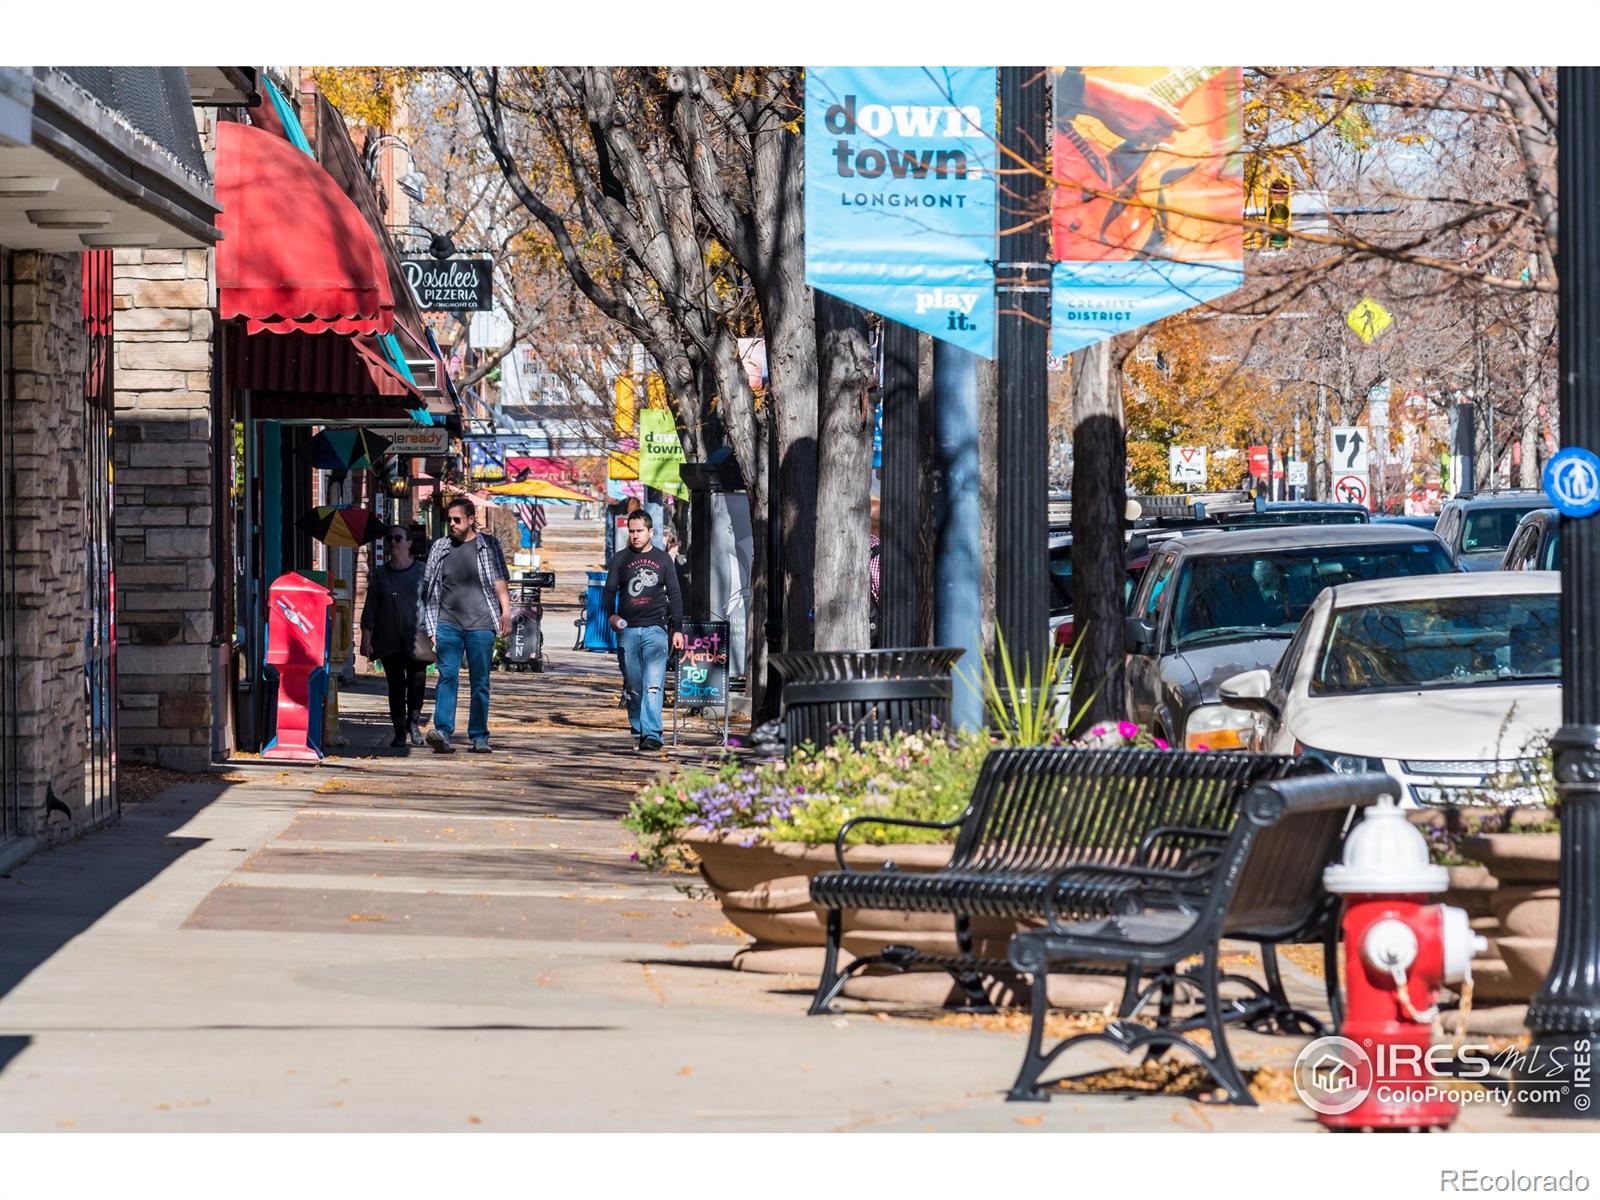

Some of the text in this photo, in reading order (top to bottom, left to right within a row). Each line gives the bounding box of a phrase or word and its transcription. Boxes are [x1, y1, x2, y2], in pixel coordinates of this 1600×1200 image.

[824, 94, 986, 138] down
[841, 192, 967, 208] LONGMONT
[401, 262, 480, 308] Rosalee's
[424, 289, 478, 300] PIZZERIA
[915, 287, 979, 315] play
[1068, 299, 1135, 308] CREATIVE
[947, 310, 977, 331] it.
[1067, 311, 1132, 321] DISTRICT
[515, 614, 524, 657] OPEN
[683, 632, 721, 652] Lost
[679, 649, 727, 667] Marbles
[682, 665, 708, 684] Toy
[680, 678, 721, 698] Store
